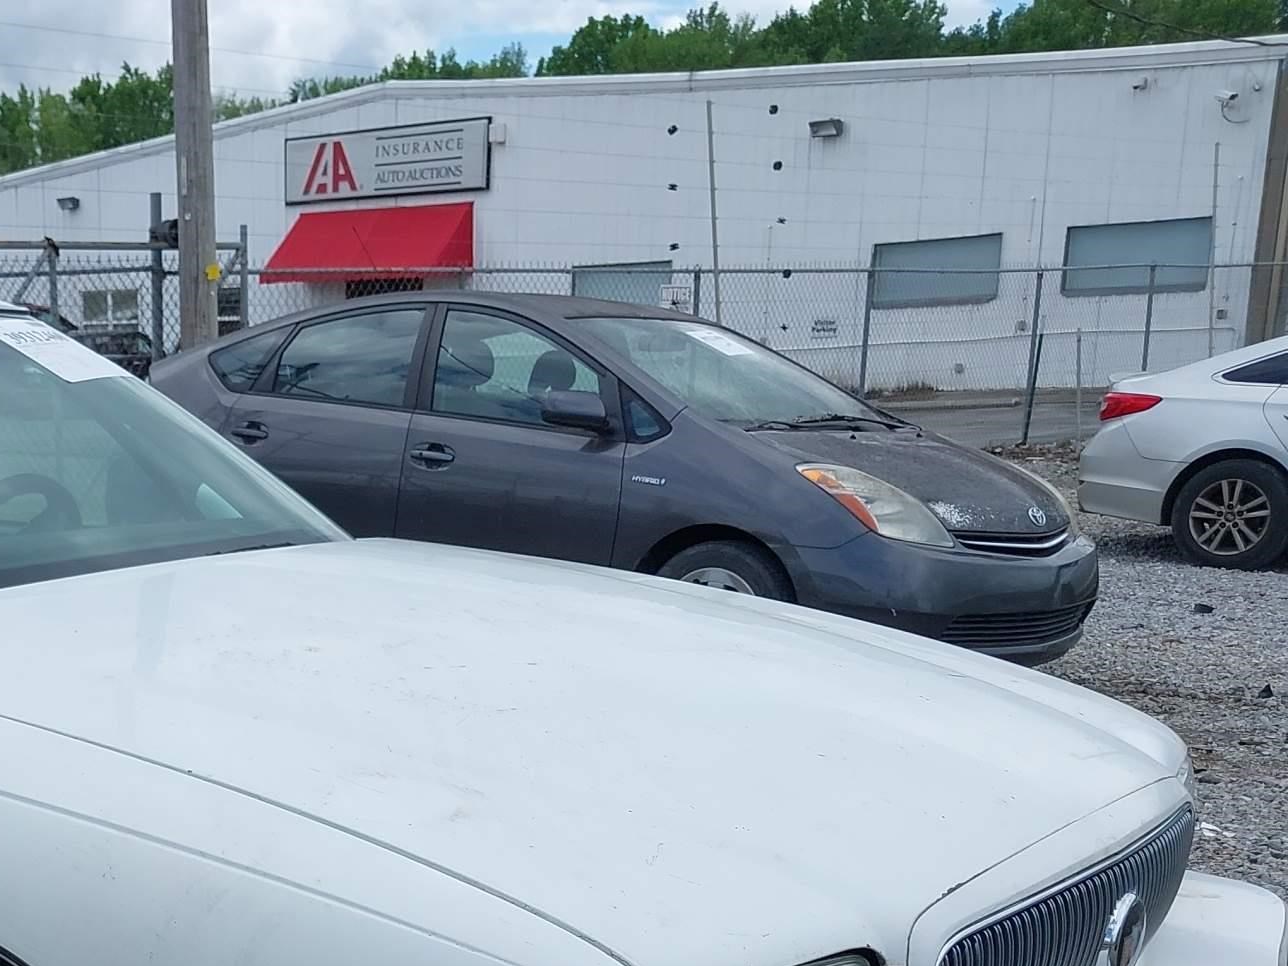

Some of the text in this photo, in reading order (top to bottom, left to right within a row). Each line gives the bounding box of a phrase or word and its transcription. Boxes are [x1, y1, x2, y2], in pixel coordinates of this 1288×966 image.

[375, 137, 464, 158] INSURANCE
[375, 165, 463, 184] AUTO AUCTIONS
